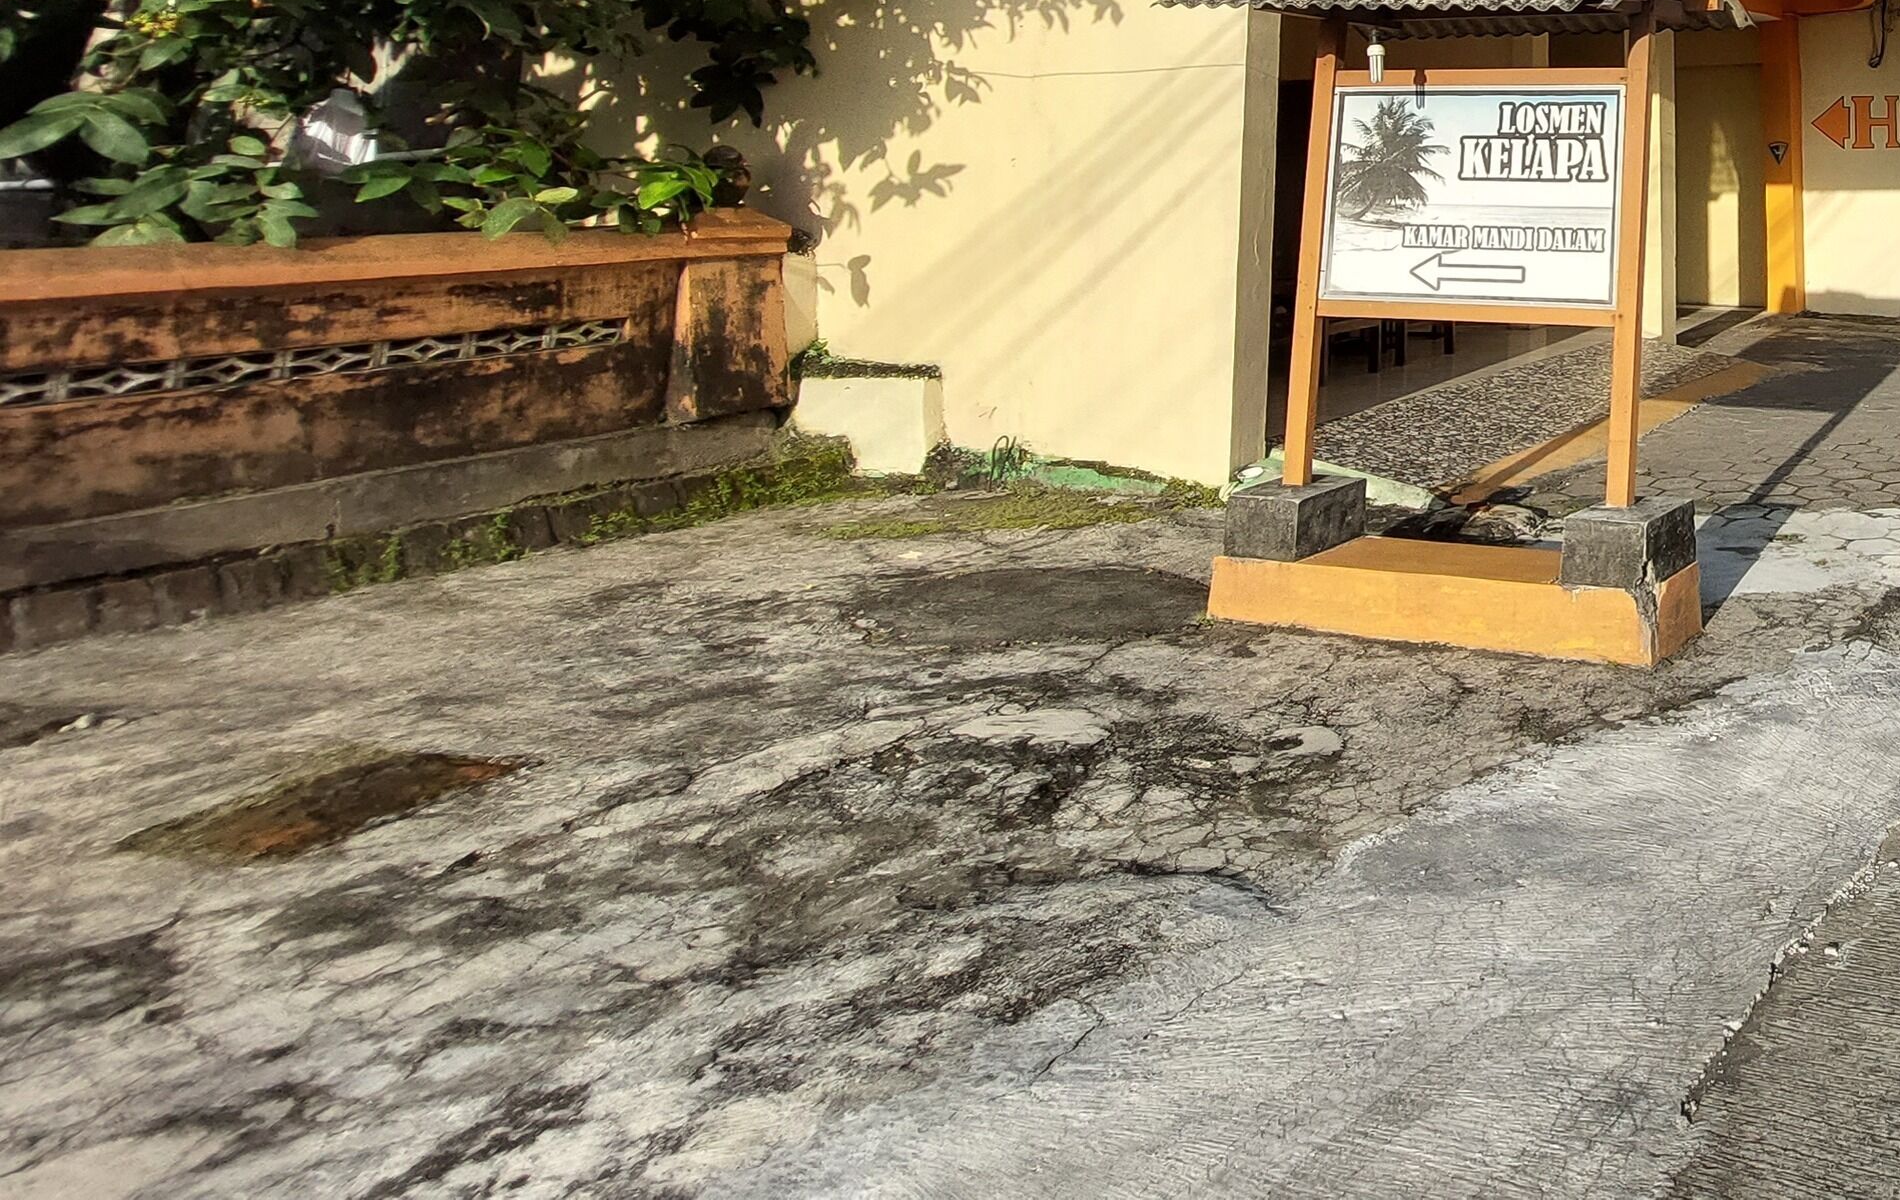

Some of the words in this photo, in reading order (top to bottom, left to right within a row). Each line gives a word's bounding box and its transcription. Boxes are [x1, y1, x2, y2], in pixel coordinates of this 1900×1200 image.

[1498, 102, 1607, 136] LOSMEN
[1458, 135, 1609, 182] KELAPA
[1402, 225, 1469, 249] KAMAR
[1472, 226, 1535, 250] MANDI
[1536, 228, 1606, 252] DALAM
